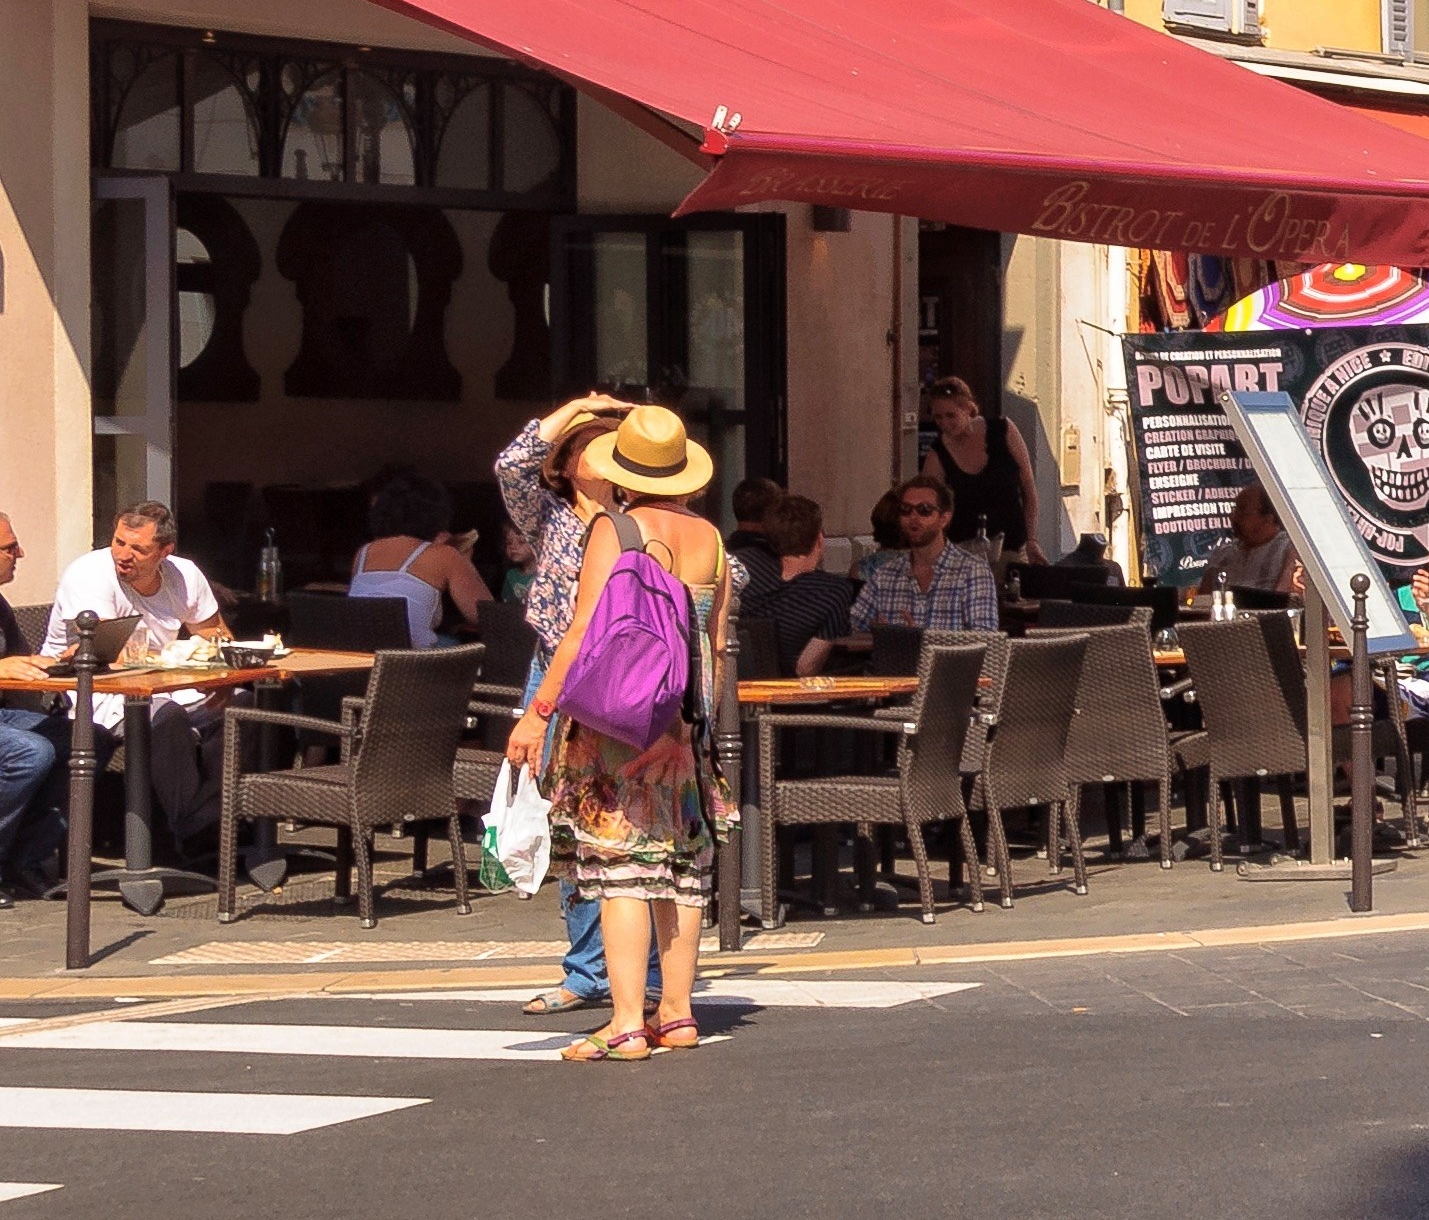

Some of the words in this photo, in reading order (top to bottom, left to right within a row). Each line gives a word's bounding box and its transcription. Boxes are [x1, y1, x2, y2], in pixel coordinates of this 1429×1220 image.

[1031, 180, 1185, 245] BISTROT
[1335, 352, 1373, 385] NICE
[1136, 362, 1283, 407] POPART
[1144, 430, 1193, 444] CREATION
[1146, 444, 1180, 459] CARTE
[1181, 444, 1194, 456] DE
[1195, 443, 1226, 456] VISITE
[1148, 460, 1177, 474] FLYER
[1186, 458, 1237, 471] BROCHURE
[1149, 473, 1199, 490] ENSEIGNE
[1151, 489, 1196, 504] STICKER
[1153, 502, 1217, 520] IMPRESSION
[1154, 518, 1207, 534] BOUTIQUE
[1208, 518, 1221, 530] EN
